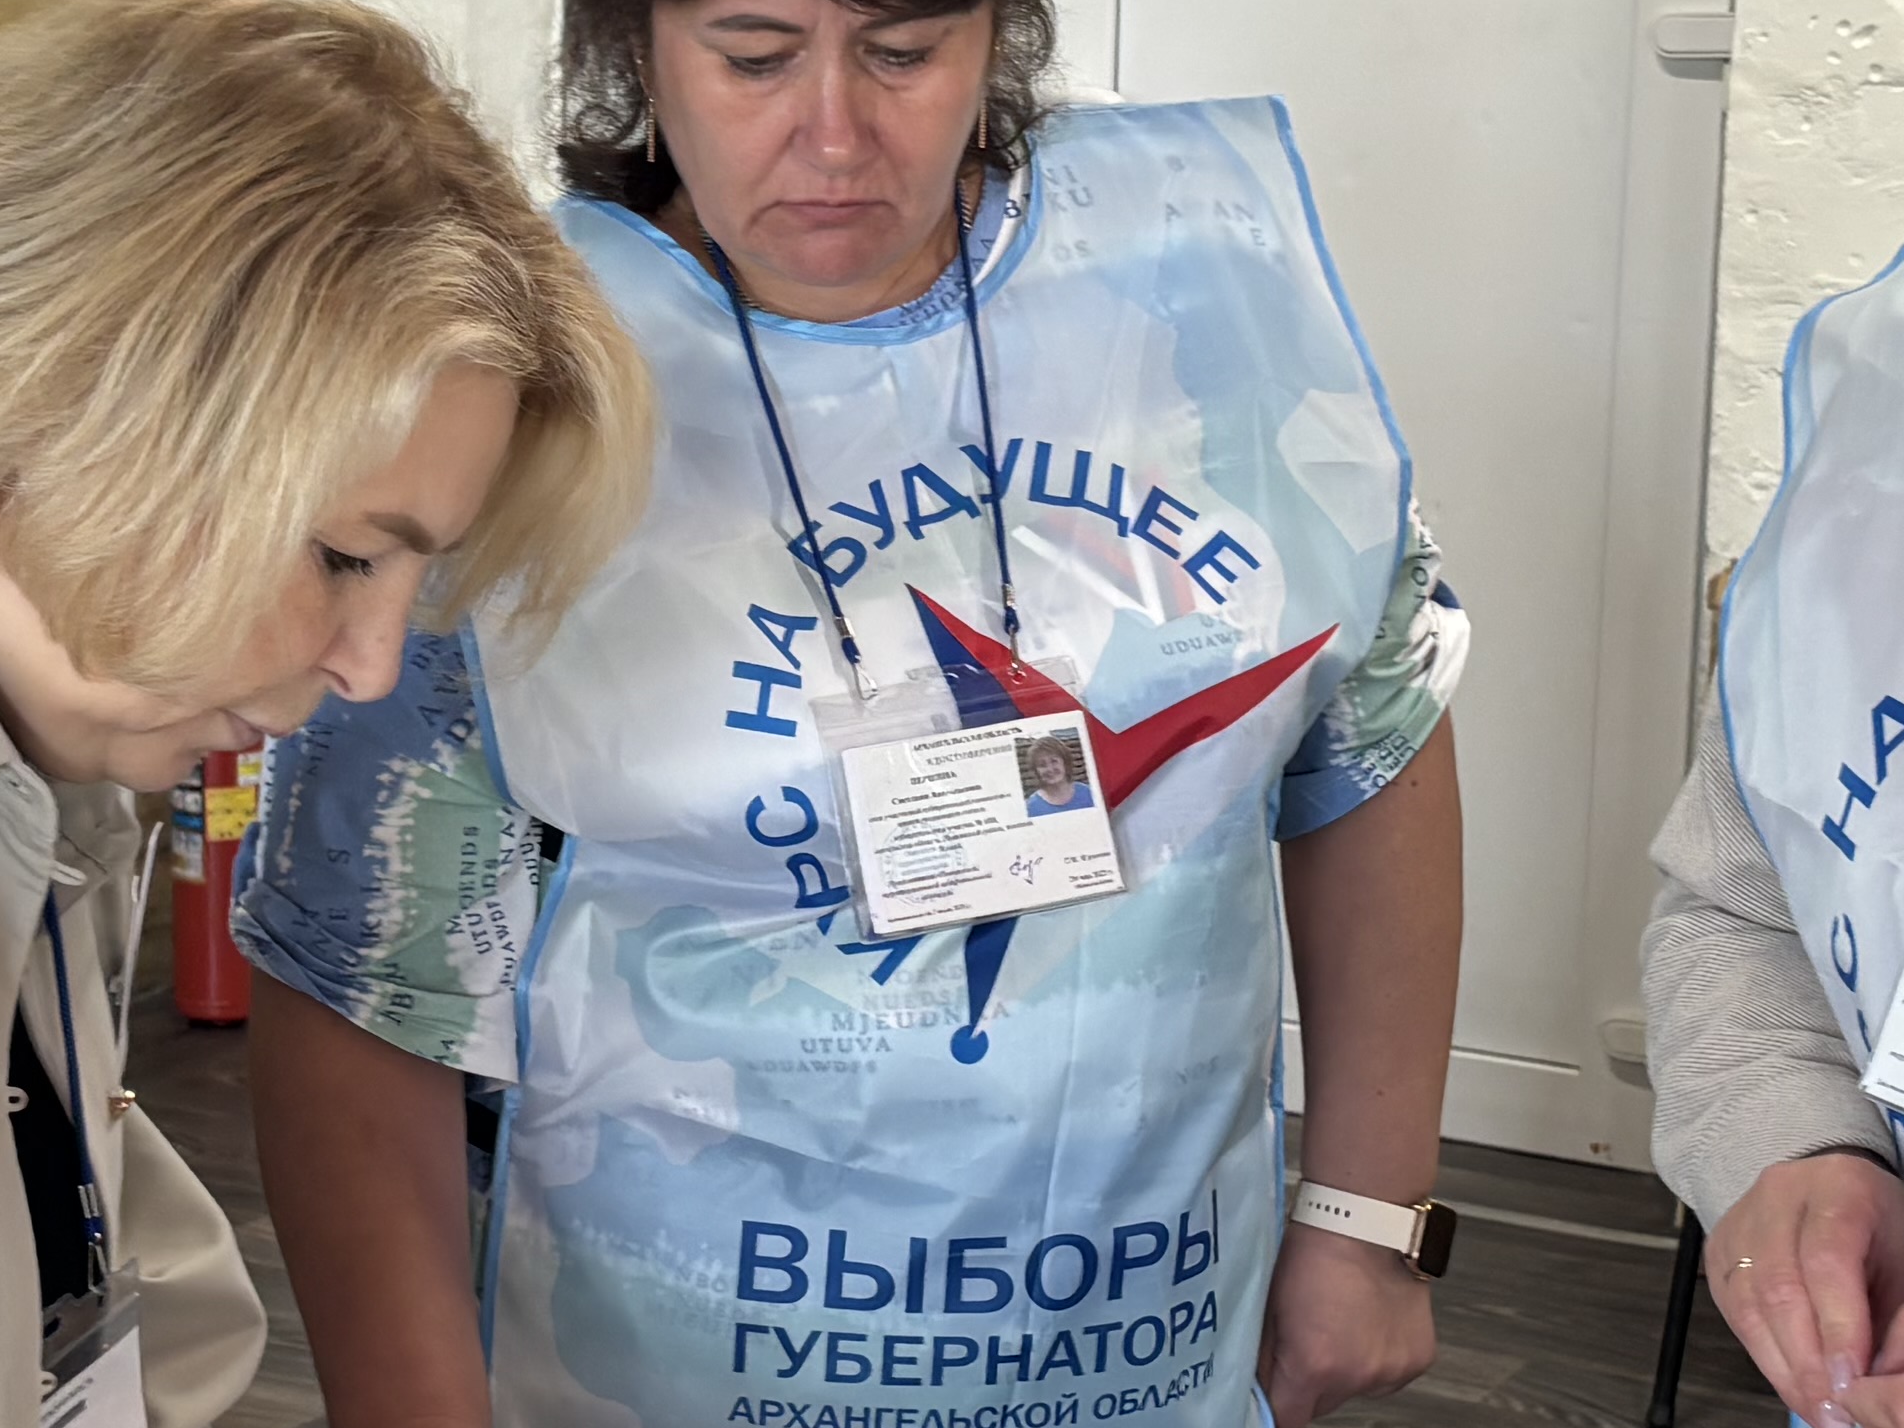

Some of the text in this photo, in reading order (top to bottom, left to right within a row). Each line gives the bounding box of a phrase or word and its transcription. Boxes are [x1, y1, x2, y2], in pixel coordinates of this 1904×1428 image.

[724, 602, 819, 738] НА
[787, 437, 1263, 605] БУДУЩЕЕ
[735, 1188, 1221, 1314] ВЫБОРЫ
[733, 1289, 1218, 1387] ГУБЕРНАТОРА
[1092, 1352, 1215, 1421] ОБЛАСТИ
